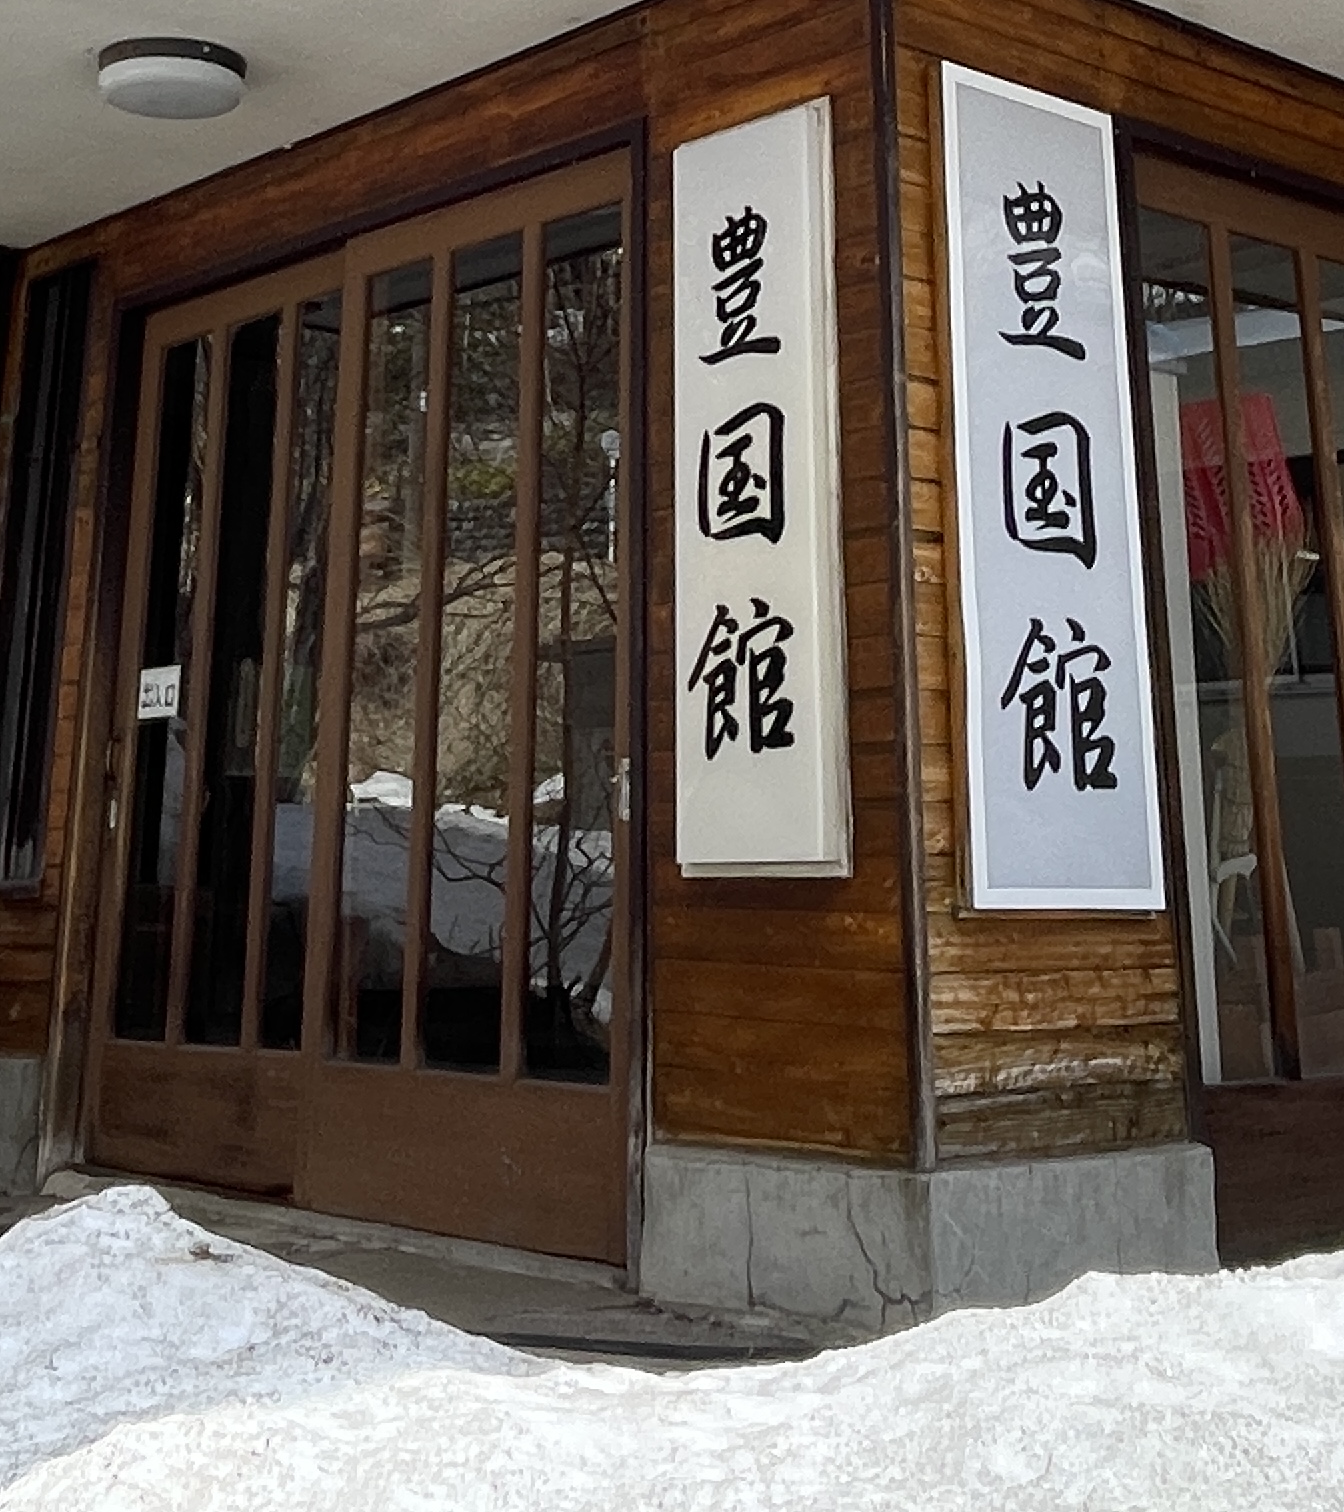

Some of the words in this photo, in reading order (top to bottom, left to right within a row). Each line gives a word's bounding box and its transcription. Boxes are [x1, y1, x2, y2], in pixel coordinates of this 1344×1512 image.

[688, 205, 795, 760] 豊国館
[1000, 180, 1119, 792] 豊国館
